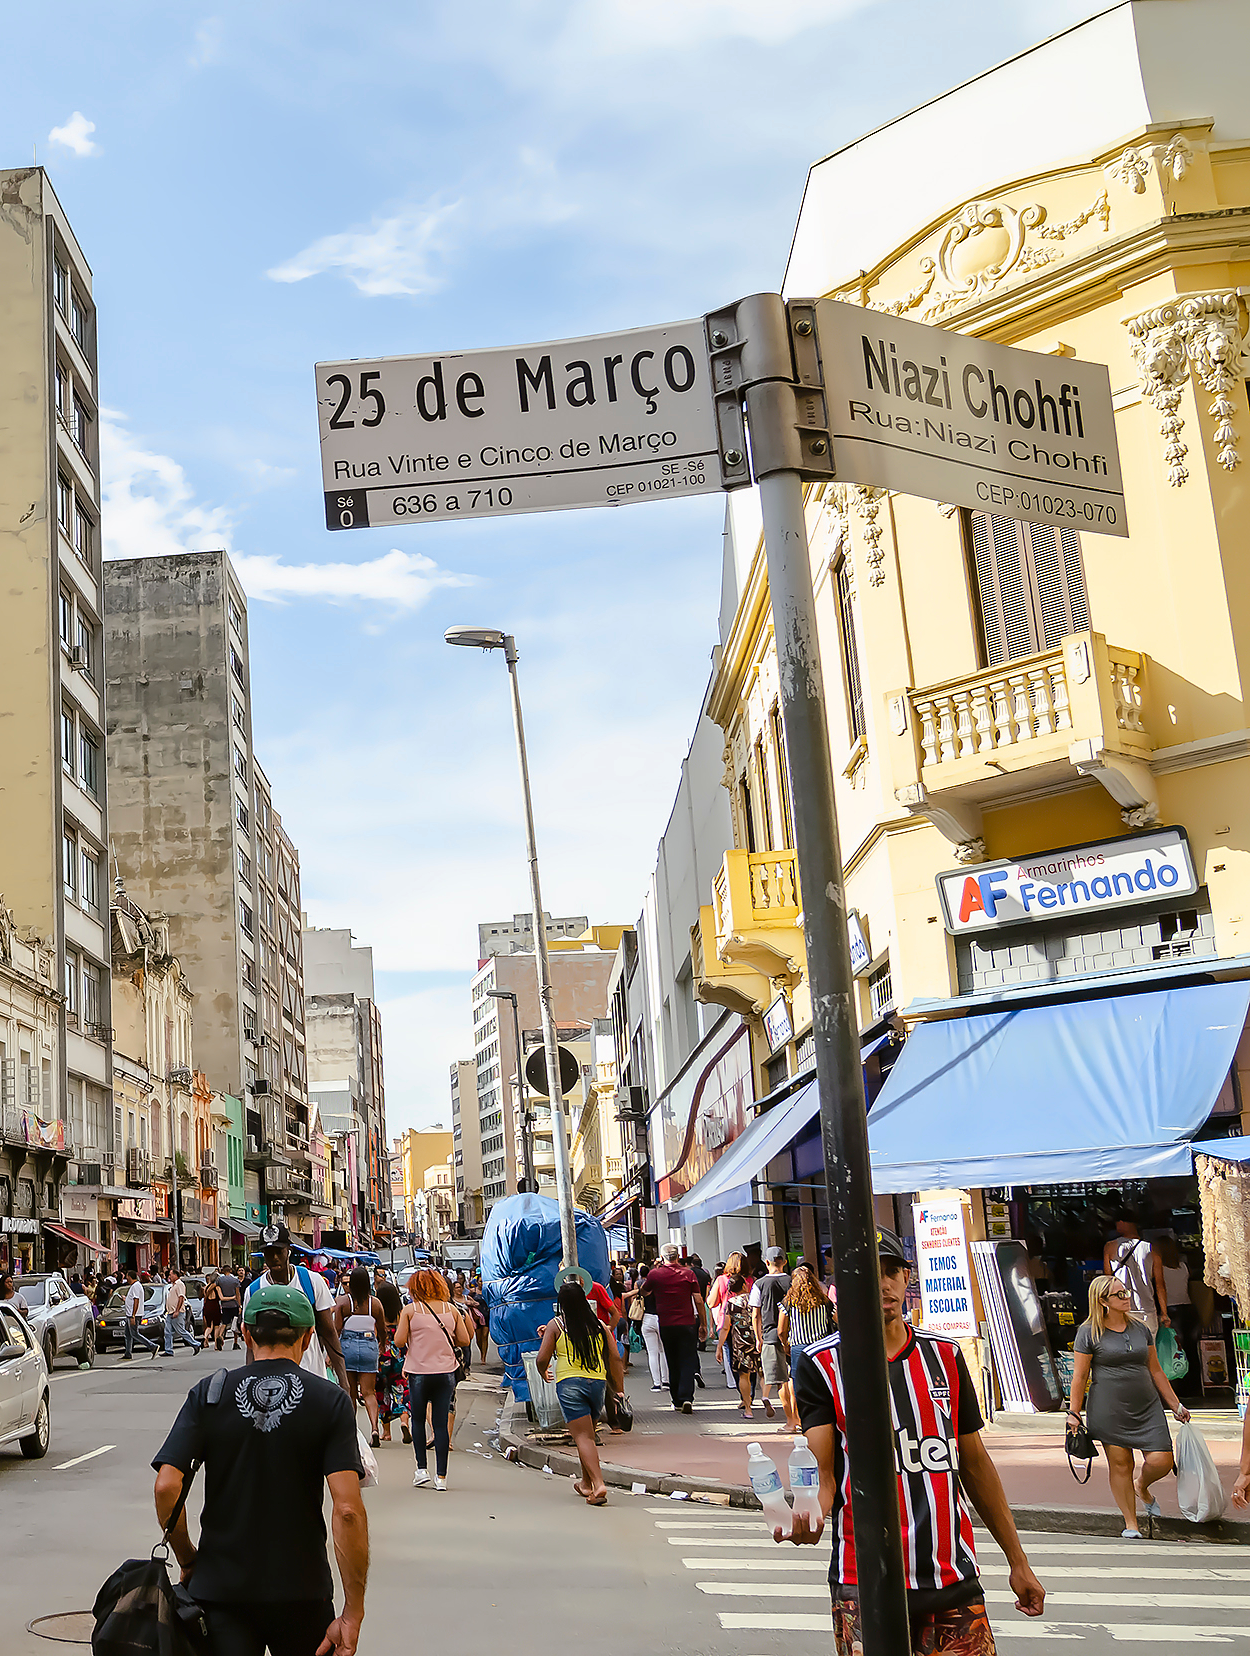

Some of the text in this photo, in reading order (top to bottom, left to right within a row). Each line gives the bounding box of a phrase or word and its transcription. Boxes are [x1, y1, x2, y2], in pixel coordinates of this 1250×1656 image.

[325, 345, 696, 430] 25 de Março
[860, 335, 1085, 439] Niazi Chohfi
[334, 431, 678, 480] Rua Vinte e Cinco de Março
[1008, 440, 1109, 476] Chohfi
[661, 463, 680, 476] SE
[606, 473, 706, 496] CEP 01021-100
[337, 496, 354, 508] Sé
[392, 487, 513, 516] 636 a 710
[976, 481, 1117, 525] CEP:01023-070
[340, 510, 354, 528] 0
[1016, 853, 1106, 881] Armarinhos
[959, 858, 1179, 923] AF Fernando
[919, 1210, 928, 1223] AF
[929, 1255, 957, 1272] TEMOS
[925, 1276, 967, 1293] MATERIAL
[929, 1297, 968, 1314] ESCOLAR
